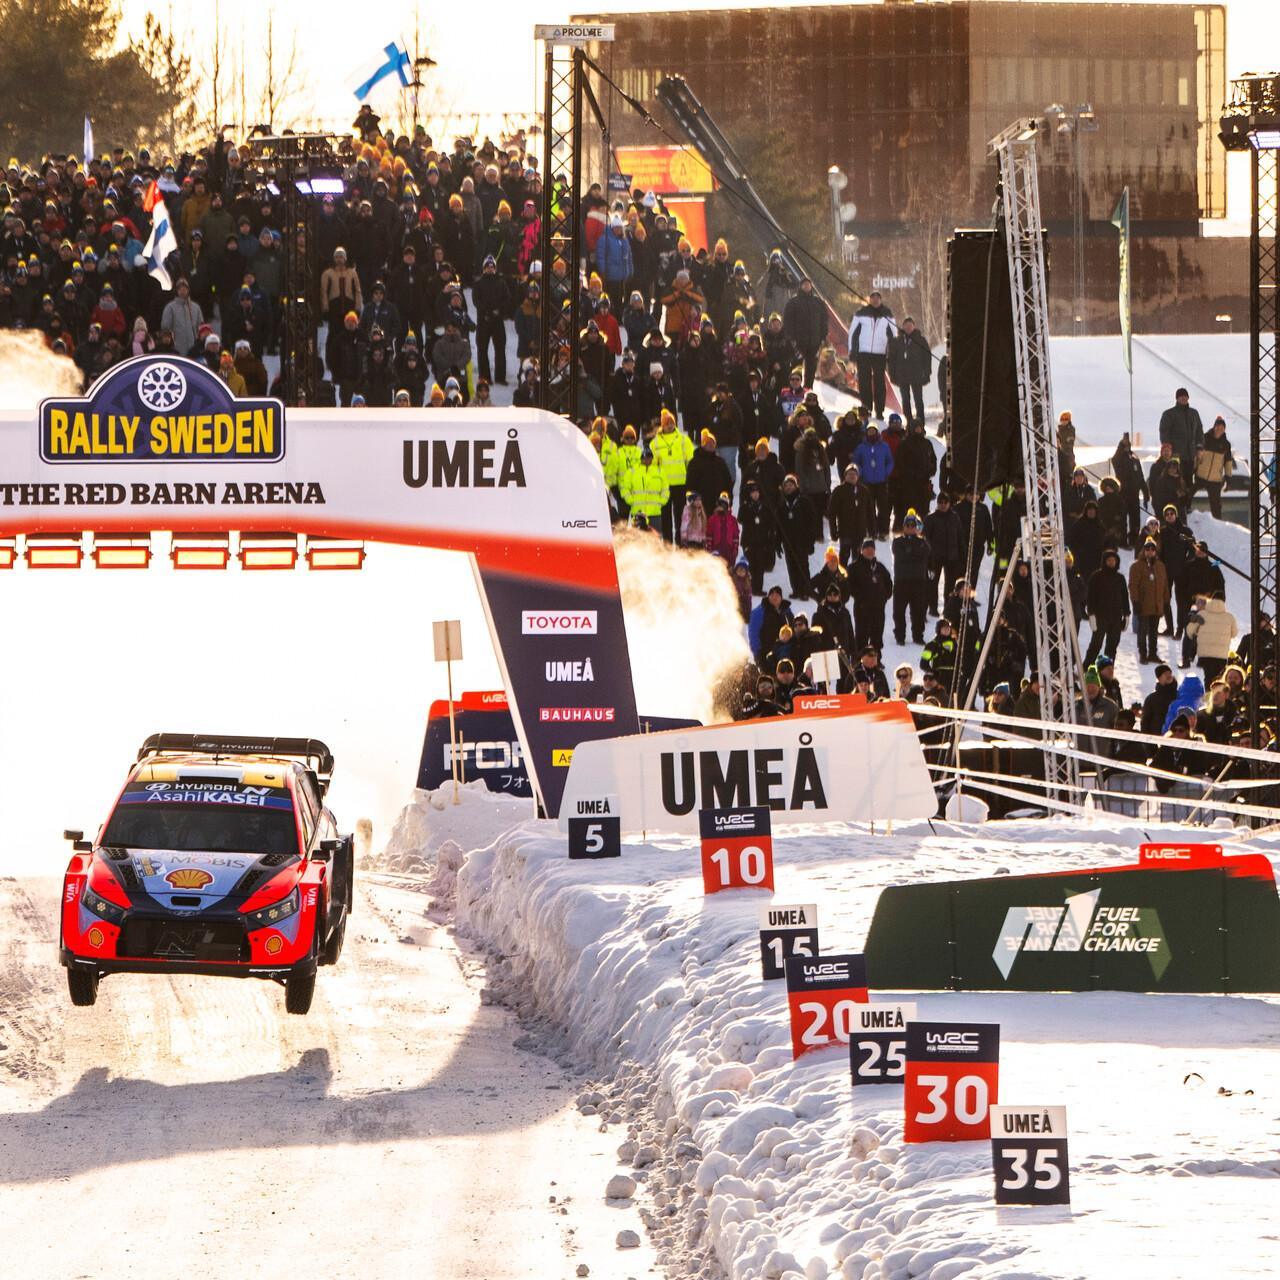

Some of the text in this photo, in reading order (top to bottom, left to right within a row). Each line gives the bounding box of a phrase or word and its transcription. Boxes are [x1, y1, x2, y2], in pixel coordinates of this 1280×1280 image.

[562, 28, 603, 37] PROLYTE
[50, 408, 274, 455] RALLY SWEDEN
[403, 428, 527, 489] UMEÅ
[64, 483, 126, 505] RED
[130, 482, 216, 505] BARN
[221, 482, 326, 505] ARENA
[562, 520, 598, 528] WRC
[526, 616, 592, 629] TOYOTA
[545, 657, 594, 682] UMEÅ
[801, 699, 841, 710] WRC
[541, 708, 615, 721] BAUHAUS
[661, 732, 828, 816] UMEÅ
[175, 783, 237, 792] HYUNDAI
[577, 797, 611, 815] UMEÅ
[715, 813, 755, 824] WRC
[585, 824, 604, 853] 5
[170, 855, 245, 869] MOBIS
[1145, 848, 1192, 859] WRC
[710, 846, 766, 886] 10
[769, 907, 807, 926] UMEÅ
[1095, 907, 1141, 921] FUEL
[1090, 922, 1129, 936] FOR
[767, 936, 814, 968] 15
[1083, 937, 1161, 952] CHANGE
[804, 962, 849, 975] WRC
[861, 1007, 905, 1029] UMEÅ
[926, 1032, 980, 1044] WRC
[858, 1041, 907, 1078] 25
[915, 1075, 989, 1126] 30
[1003, 1109, 1053, 1134] UMEÅ
[1001, 1149, 1062, 1190] 35
